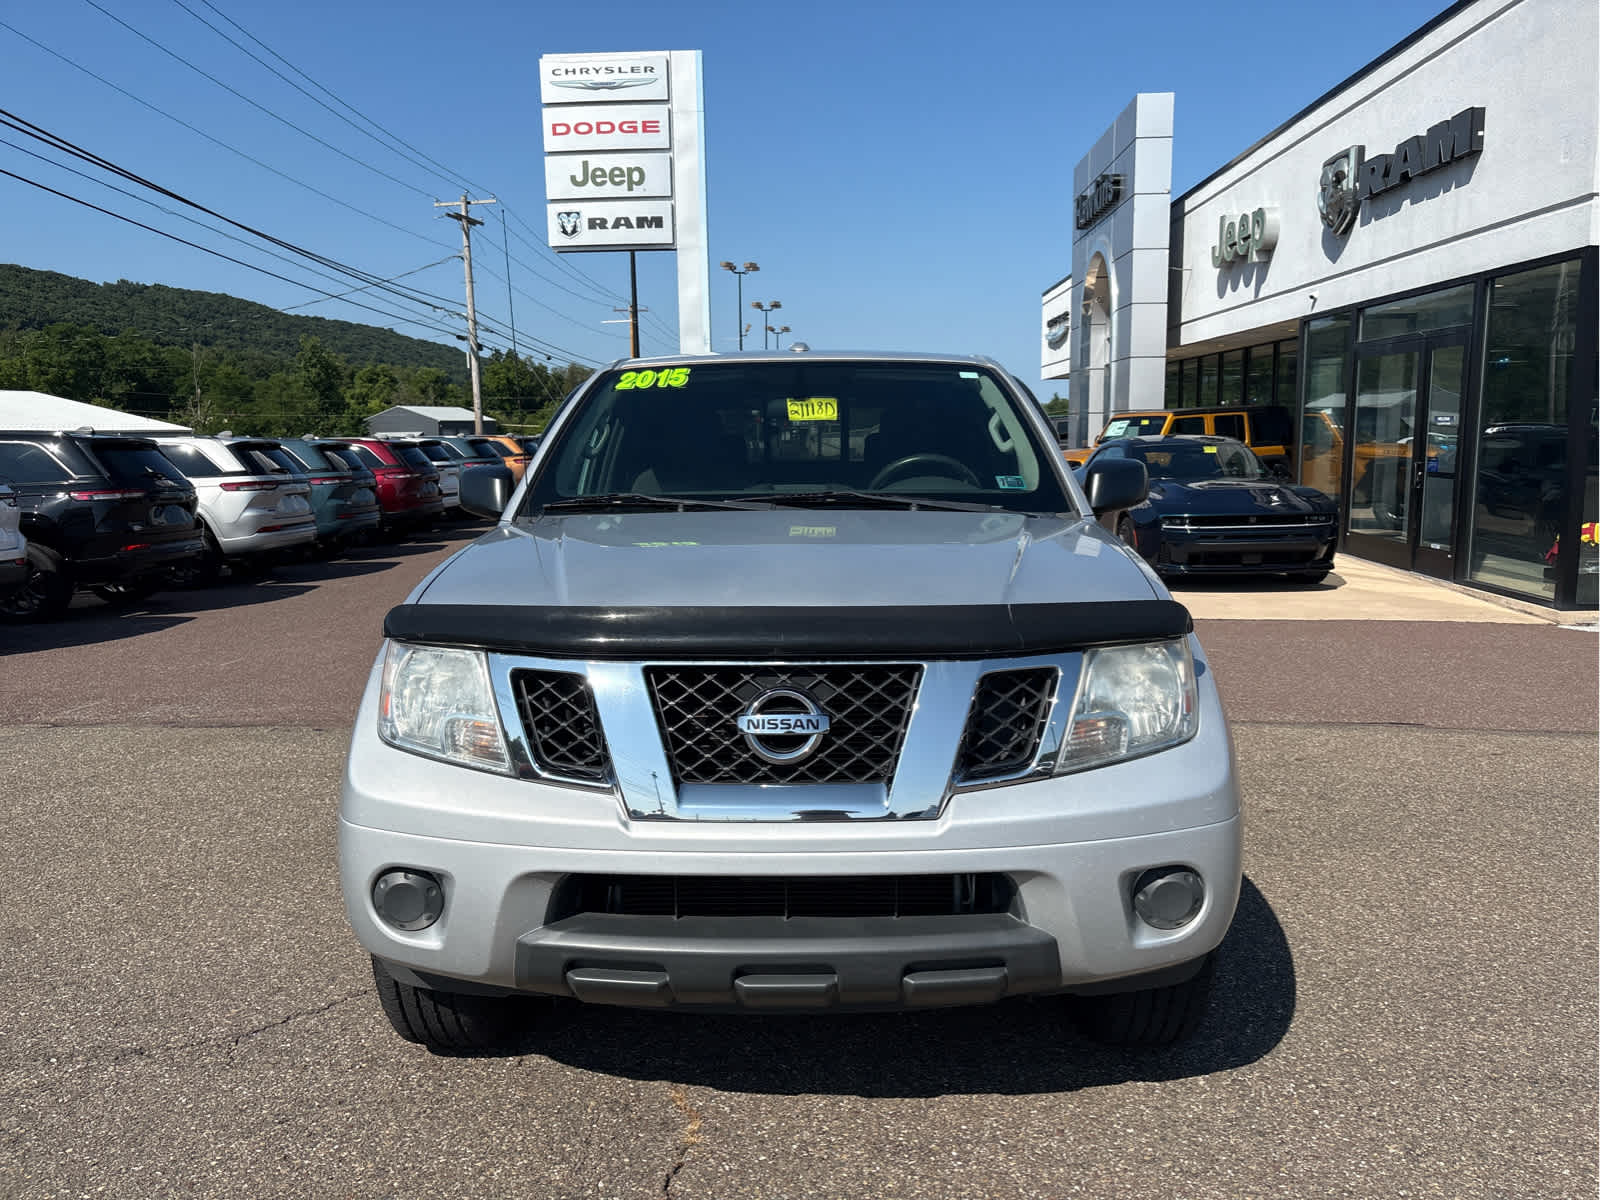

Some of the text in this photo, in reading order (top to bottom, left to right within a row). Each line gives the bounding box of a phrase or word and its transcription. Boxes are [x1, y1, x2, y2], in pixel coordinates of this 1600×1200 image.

[552, 65, 656, 76] CHRYSLER
[551, 120, 661, 136] DODGE
[1357, 106, 1486, 200] RAM
[570, 160, 646, 192] Jeep
[587, 215, 664, 230] RAM
[1211, 207, 1272, 268] Jeep
[615, 368, 691, 390] 2015
[746, 718, 820, 730] NISSAN
